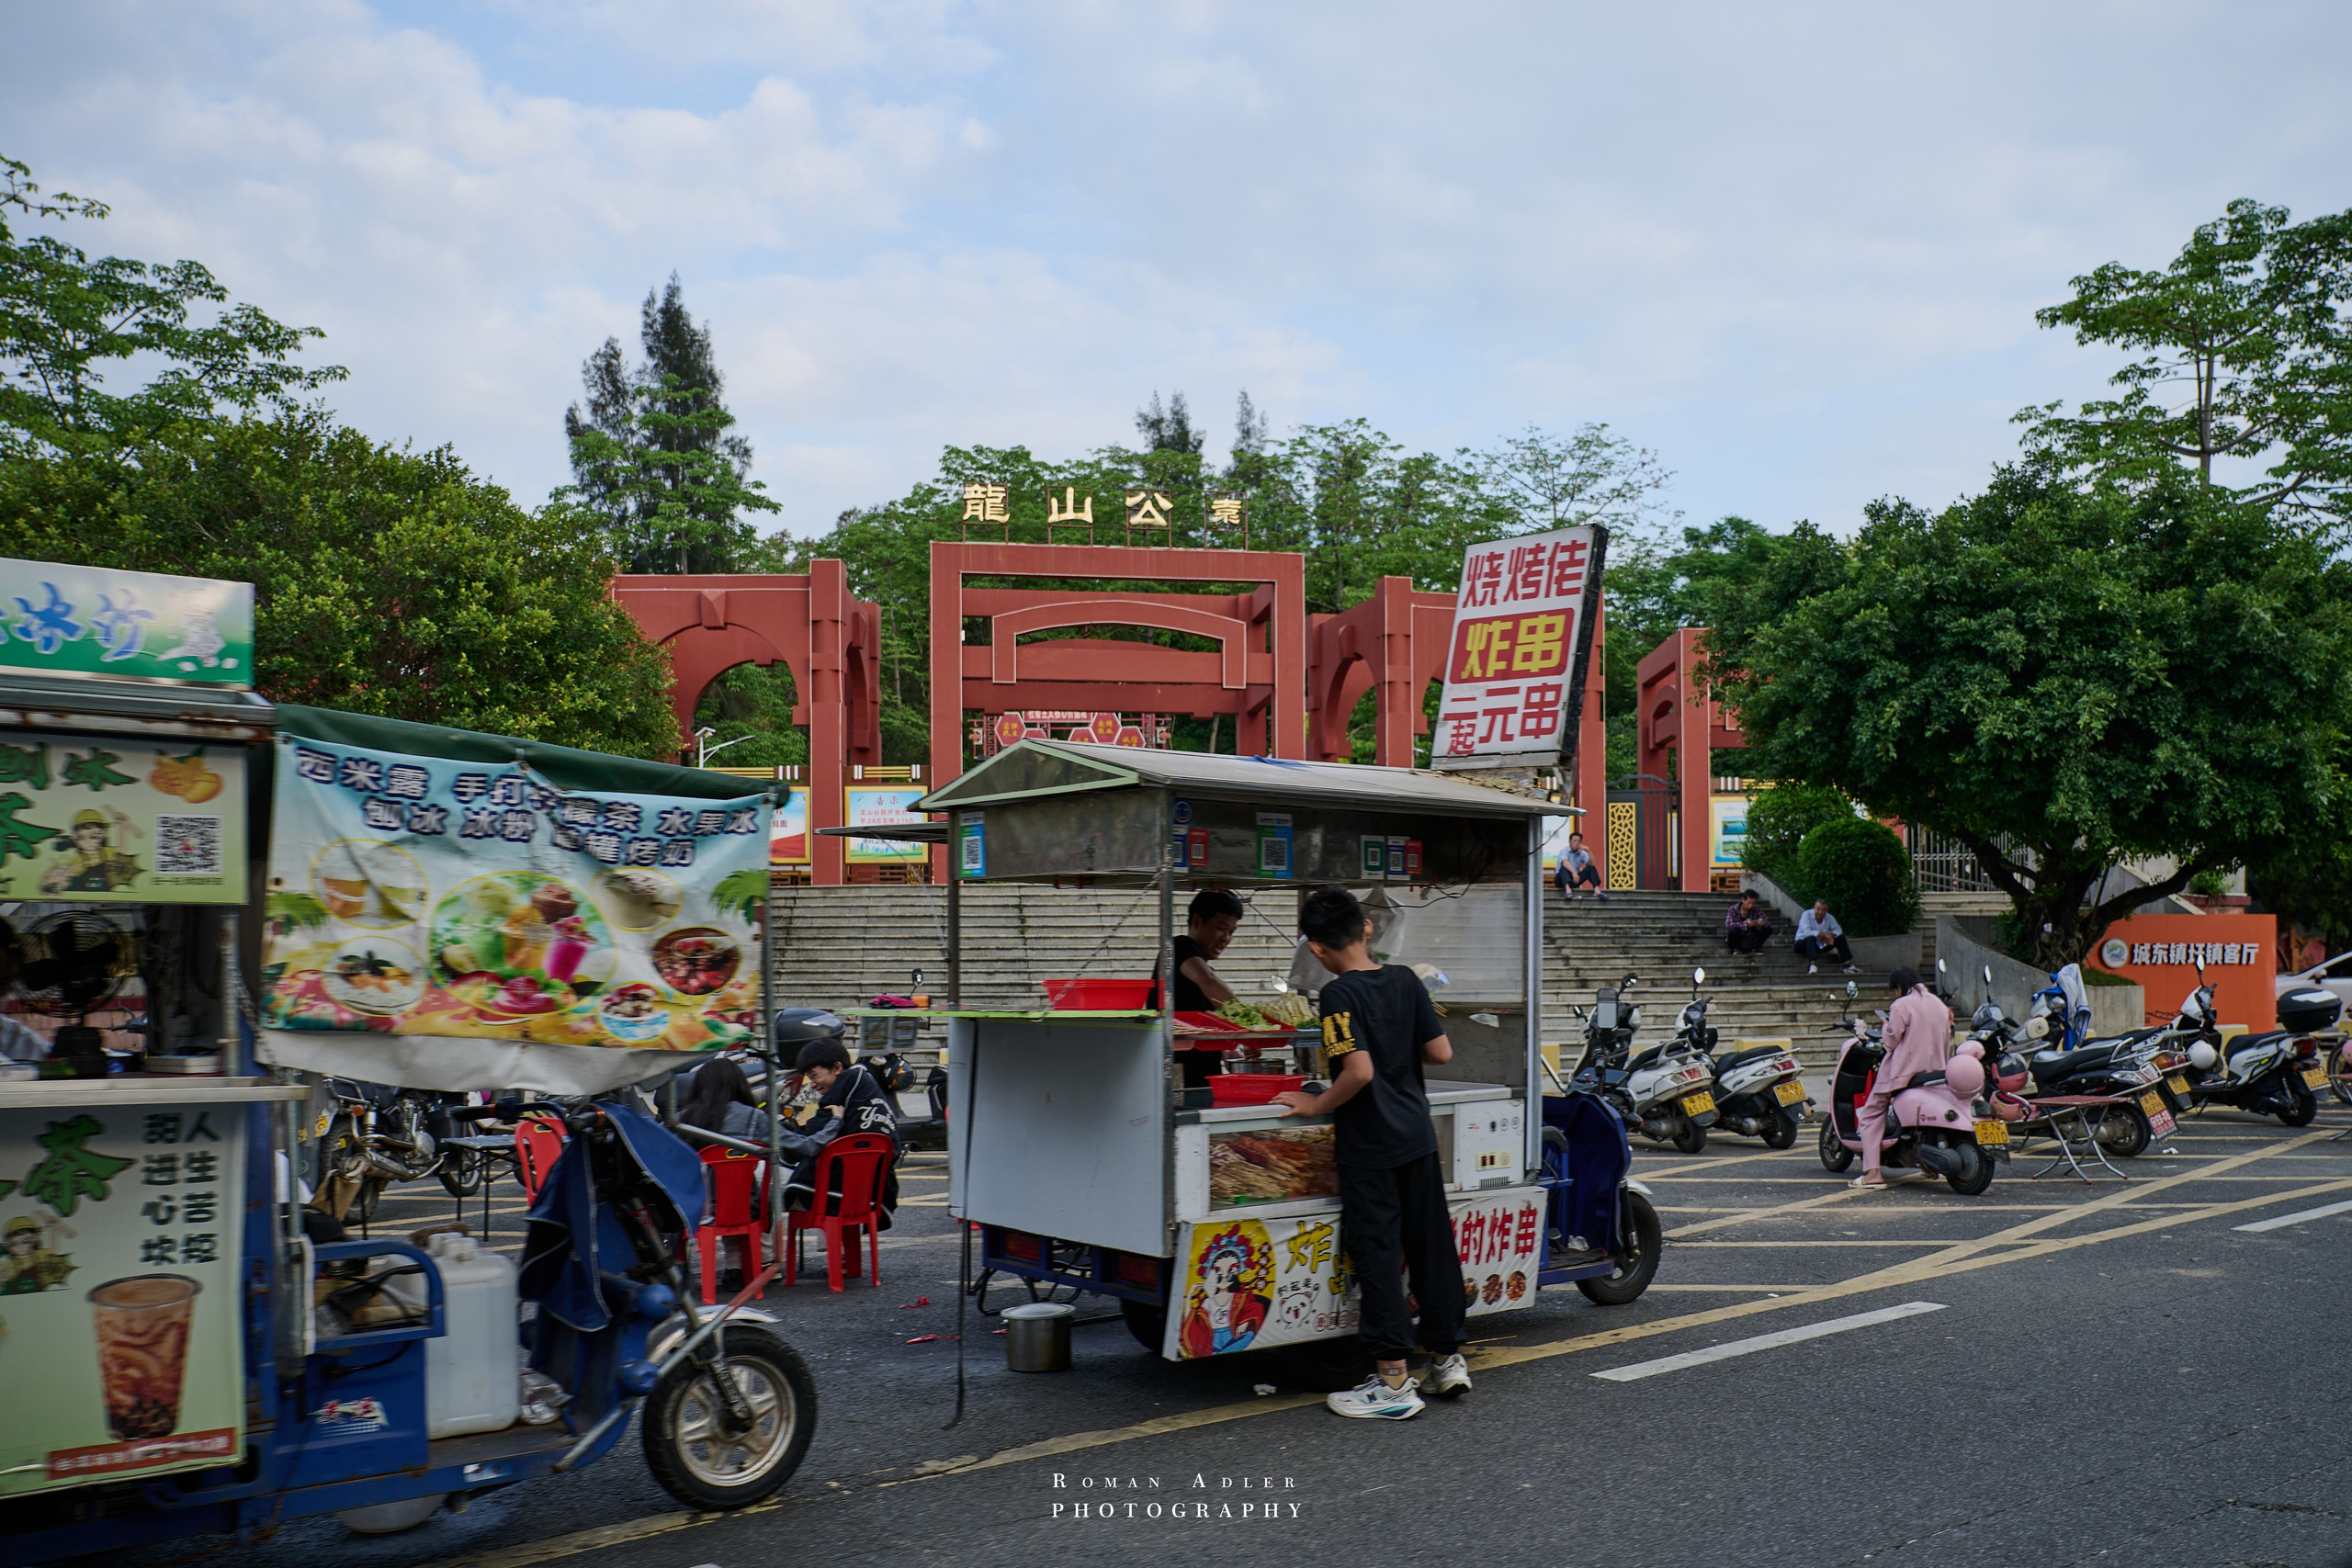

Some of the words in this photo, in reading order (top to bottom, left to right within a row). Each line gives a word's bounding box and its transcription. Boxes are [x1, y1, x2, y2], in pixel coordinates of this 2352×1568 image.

[0, 581, 155, 662] 冰沙
[1460, 615, 1566, 680] 炸串
[296, 747, 429, 800] 西米露
[655, 806, 760, 837] 水果冰
[459, 806, 537, 843] 冰粉
[182, 1111, 221, 1265] 人生苦短
[1450, 1207, 1537, 1266] 的炸串
